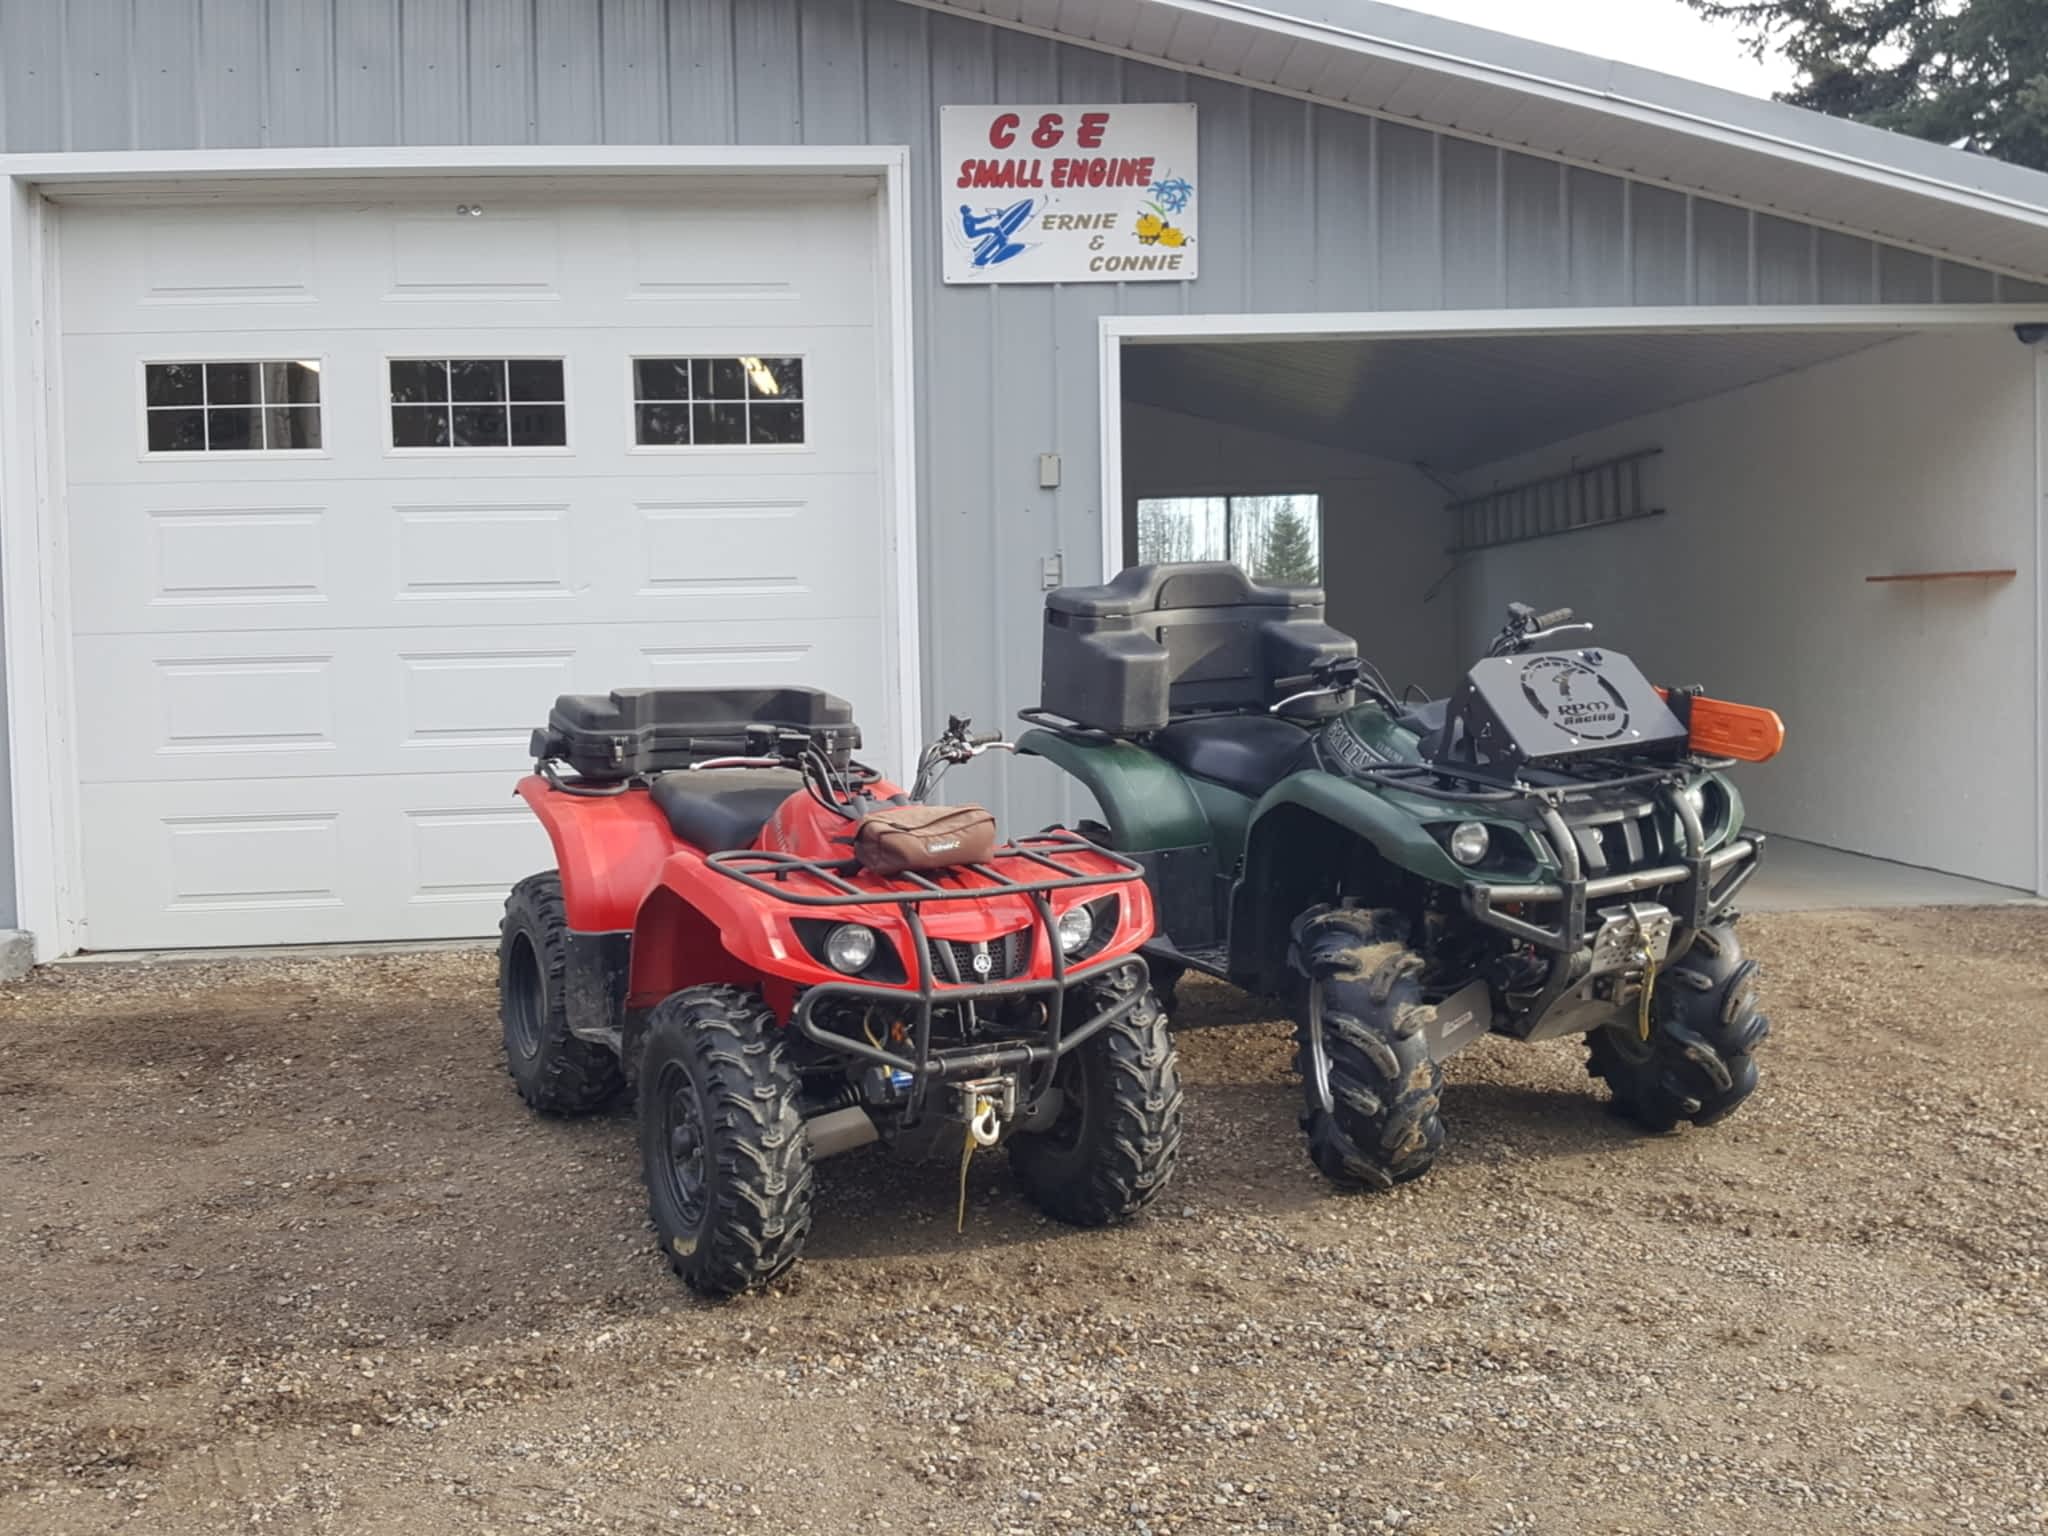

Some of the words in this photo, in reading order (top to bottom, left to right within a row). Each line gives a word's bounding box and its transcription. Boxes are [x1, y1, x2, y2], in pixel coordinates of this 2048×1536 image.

[989, 113, 1020, 149] C
[1031, 113, 1064, 149] &
[1077, 113, 1109, 148] E
[957, 159, 1043, 189] SMALL
[1051, 157, 1155, 188] ENGINE
[1041, 213, 1118, 231] ERNIE
[1088, 235, 1105, 251] &
[1089, 254, 1183, 272] CONNIE
